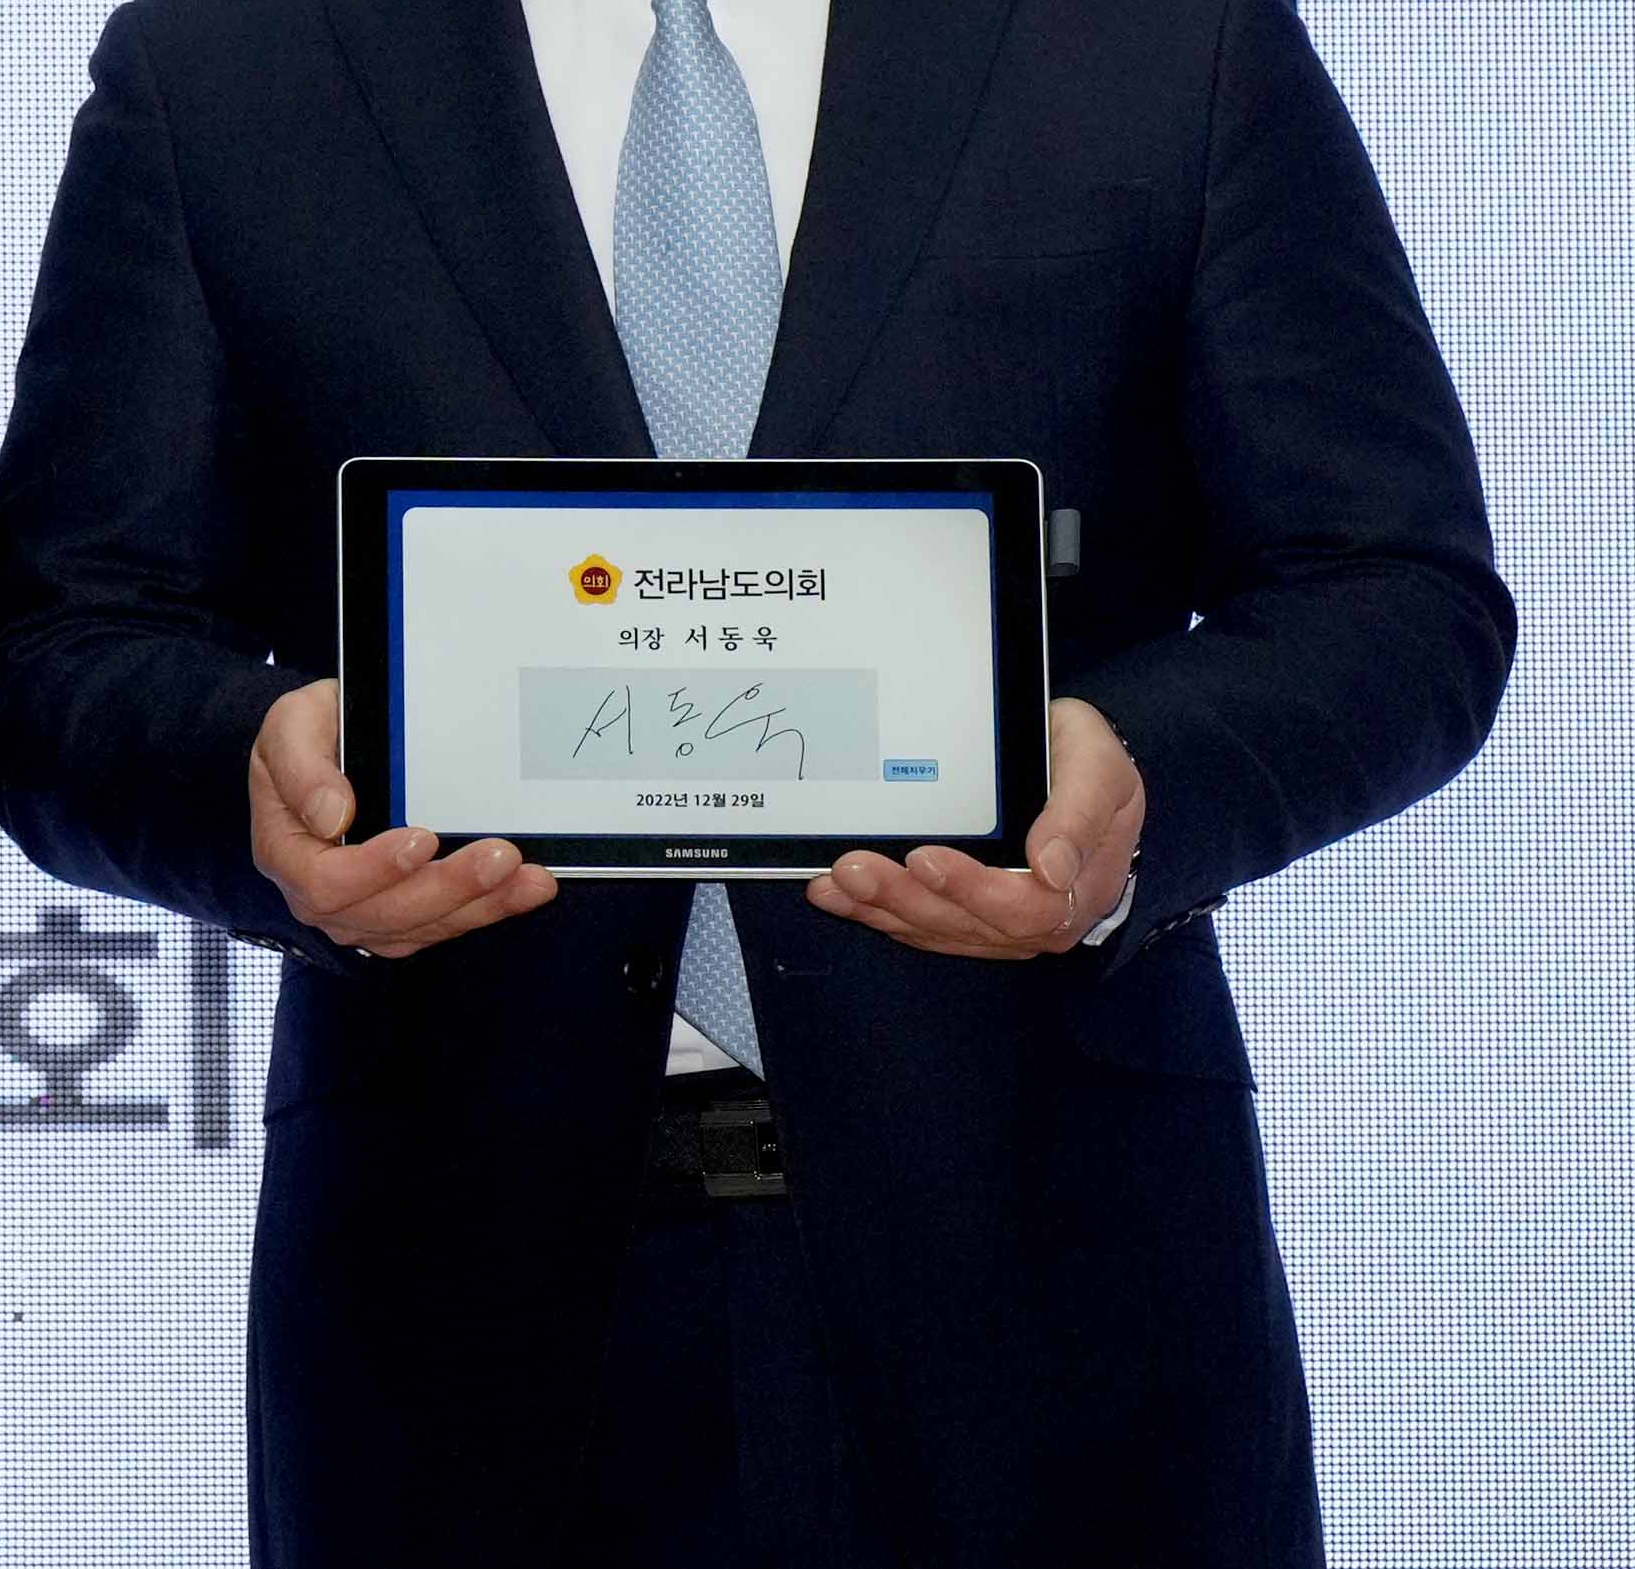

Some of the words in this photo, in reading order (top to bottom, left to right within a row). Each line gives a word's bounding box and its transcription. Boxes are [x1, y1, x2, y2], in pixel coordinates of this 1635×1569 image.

[634, 568, 826, 601] 전라남도의회
[618, 626, 665, 651] 의장
[635, 793, 688, 808] 2022년
[693, 793, 727, 808] 12월
[731, 793, 765, 808] 29일
[665, 848, 729, 859] SAMSUNG
